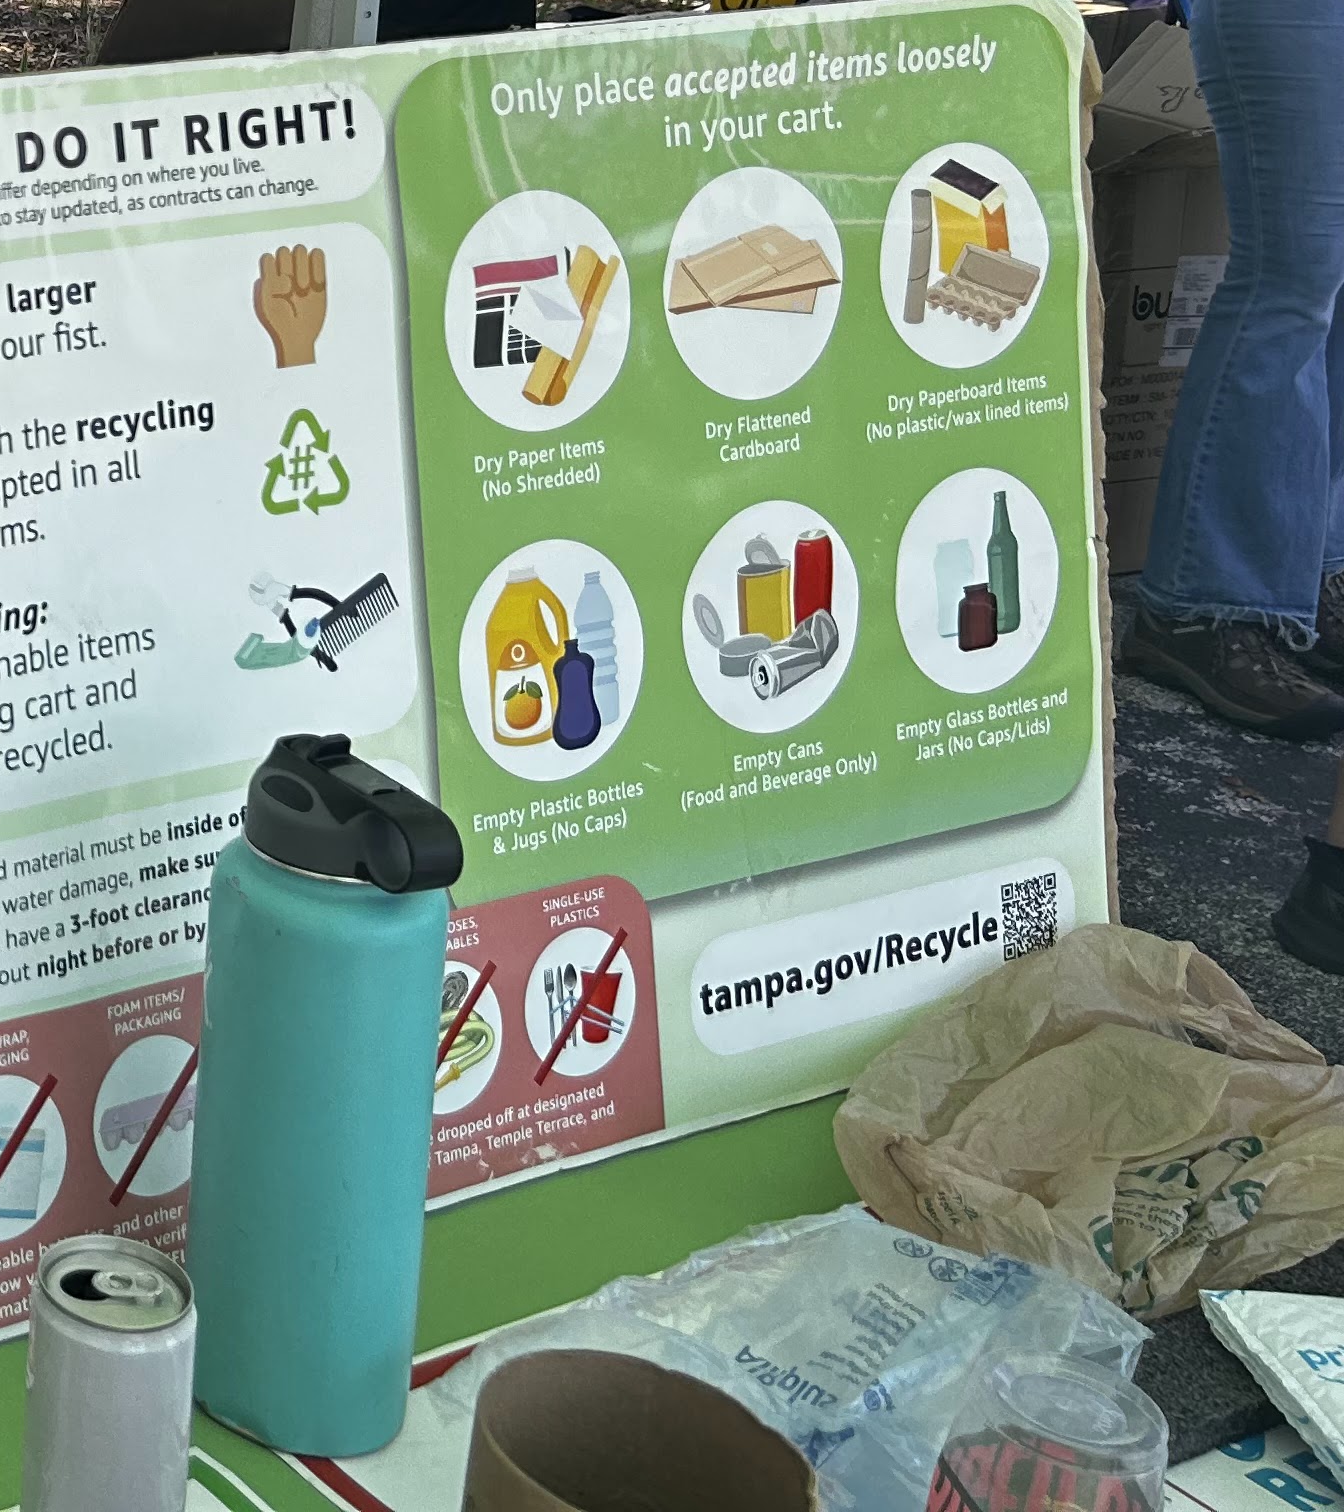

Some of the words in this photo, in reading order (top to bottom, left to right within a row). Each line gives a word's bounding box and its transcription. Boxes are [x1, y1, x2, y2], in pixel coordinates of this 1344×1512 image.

[490, 76, 562, 119] Only
[574, 63, 654, 116] place
[665, 53, 796, 100] accepted
[806, 47, 888, 84] items
[896, 33, 997, 73] loosely
[16, 126, 87, 172] DO
[113, 118, 159, 162] IT
[183, 98, 355, 155] RIGHT!
[699, 107, 767, 152] your
[777, 100, 842, 134] cart.
[30, 173, 117, 198] depending
[146, 165, 195, 183] where
[232, 157, 264, 174] live.
[14, 207, 46, 225] stay
[50, 195, 122, 222] updated,
[148, 186, 222, 208] contracts
[258, 178, 318, 196] change.
[6, 280, 96, 315] larger
[52, 321, 106, 352] fist.
[887, 394, 913, 413] Dry
[918, 377, 1002, 408] Paperboard
[1006, 375, 1046, 393] Items
[76, 399, 213, 442] recycling
[705, 421, 732, 440] Dry
[737, 405, 810, 434] Flattened
[866, 421, 892, 443] (No
[896, 409, 981, 439] plastic/wax
[985, 399, 1020, 421] lined
[1024, 391, 1068, 414] items)
[474, 455, 503, 475] Dry
[508, 447, 555, 469] Paper
[559, 440, 604, 459] Items
[719, 432, 799, 462] Cardboard
[482, 479, 511, 501] (No
[516, 461, 600, 493] Shredded)
[77, 628, 155, 662] items
[25, 683, 76, 719] cart
[85, 668, 136, 706] and
[896, 718, 942, 740] Empty
[946, 709, 984, 728] Glass
[988, 696, 1038, 720] Bottles
[915, 742, 944, 760] Jars
[947, 734, 973, 756] (No
[977, 714, 1050, 747] Caps/Lids)
[733, 748, 782, 772] Empty
[787, 741, 823, 760] Cans
[680, 782, 724, 812] (Food
[762, 764, 831, 791] Beverage
[835, 750, 877, 775] Only)
[473, 807, 525, 832] Empty
[530, 792, 582, 819] Plastic
[587, 780, 643, 806] Bottles
[13, 841, 85, 877] material
[90, 833, 134, 858] must
[166, 812, 222, 841] inside
[510, 829, 547, 851] Jugs
[551, 820, 579, 844] (No
[584, 806, 626, 833] Caps)
[2, 889, 53, 914] water
[59, 871, 132, 900] damage,
[139, 856, 189, 882] make
[542, 886, 604, 912] SINGLE-USE
[5, 926, 50, 948] have
[70, 903, 129, 933] 3-foot
[550, 904, 599, 927] PLASTICS
[37, 948, 88, 978] night
[91, 935, 152, 963] before
[699, 910, 997, 1015] tampa.gov/Recycle
[107, 999, 140, 1019] FOAM
[143, 987, 185, 1009] ITEMS/
[114, 1006, 181, 1035] PACKAGING
[436, 1112, 492, 1142] dropped
[533, 1081, 604, 1114] designated
[433, 1142, 481, 1165] Tampa,
[485, 1124, 532, 1149] Temple
[534, 1112, 586, 1135] Terrace,
[144, 1205, 183, 1226] other
